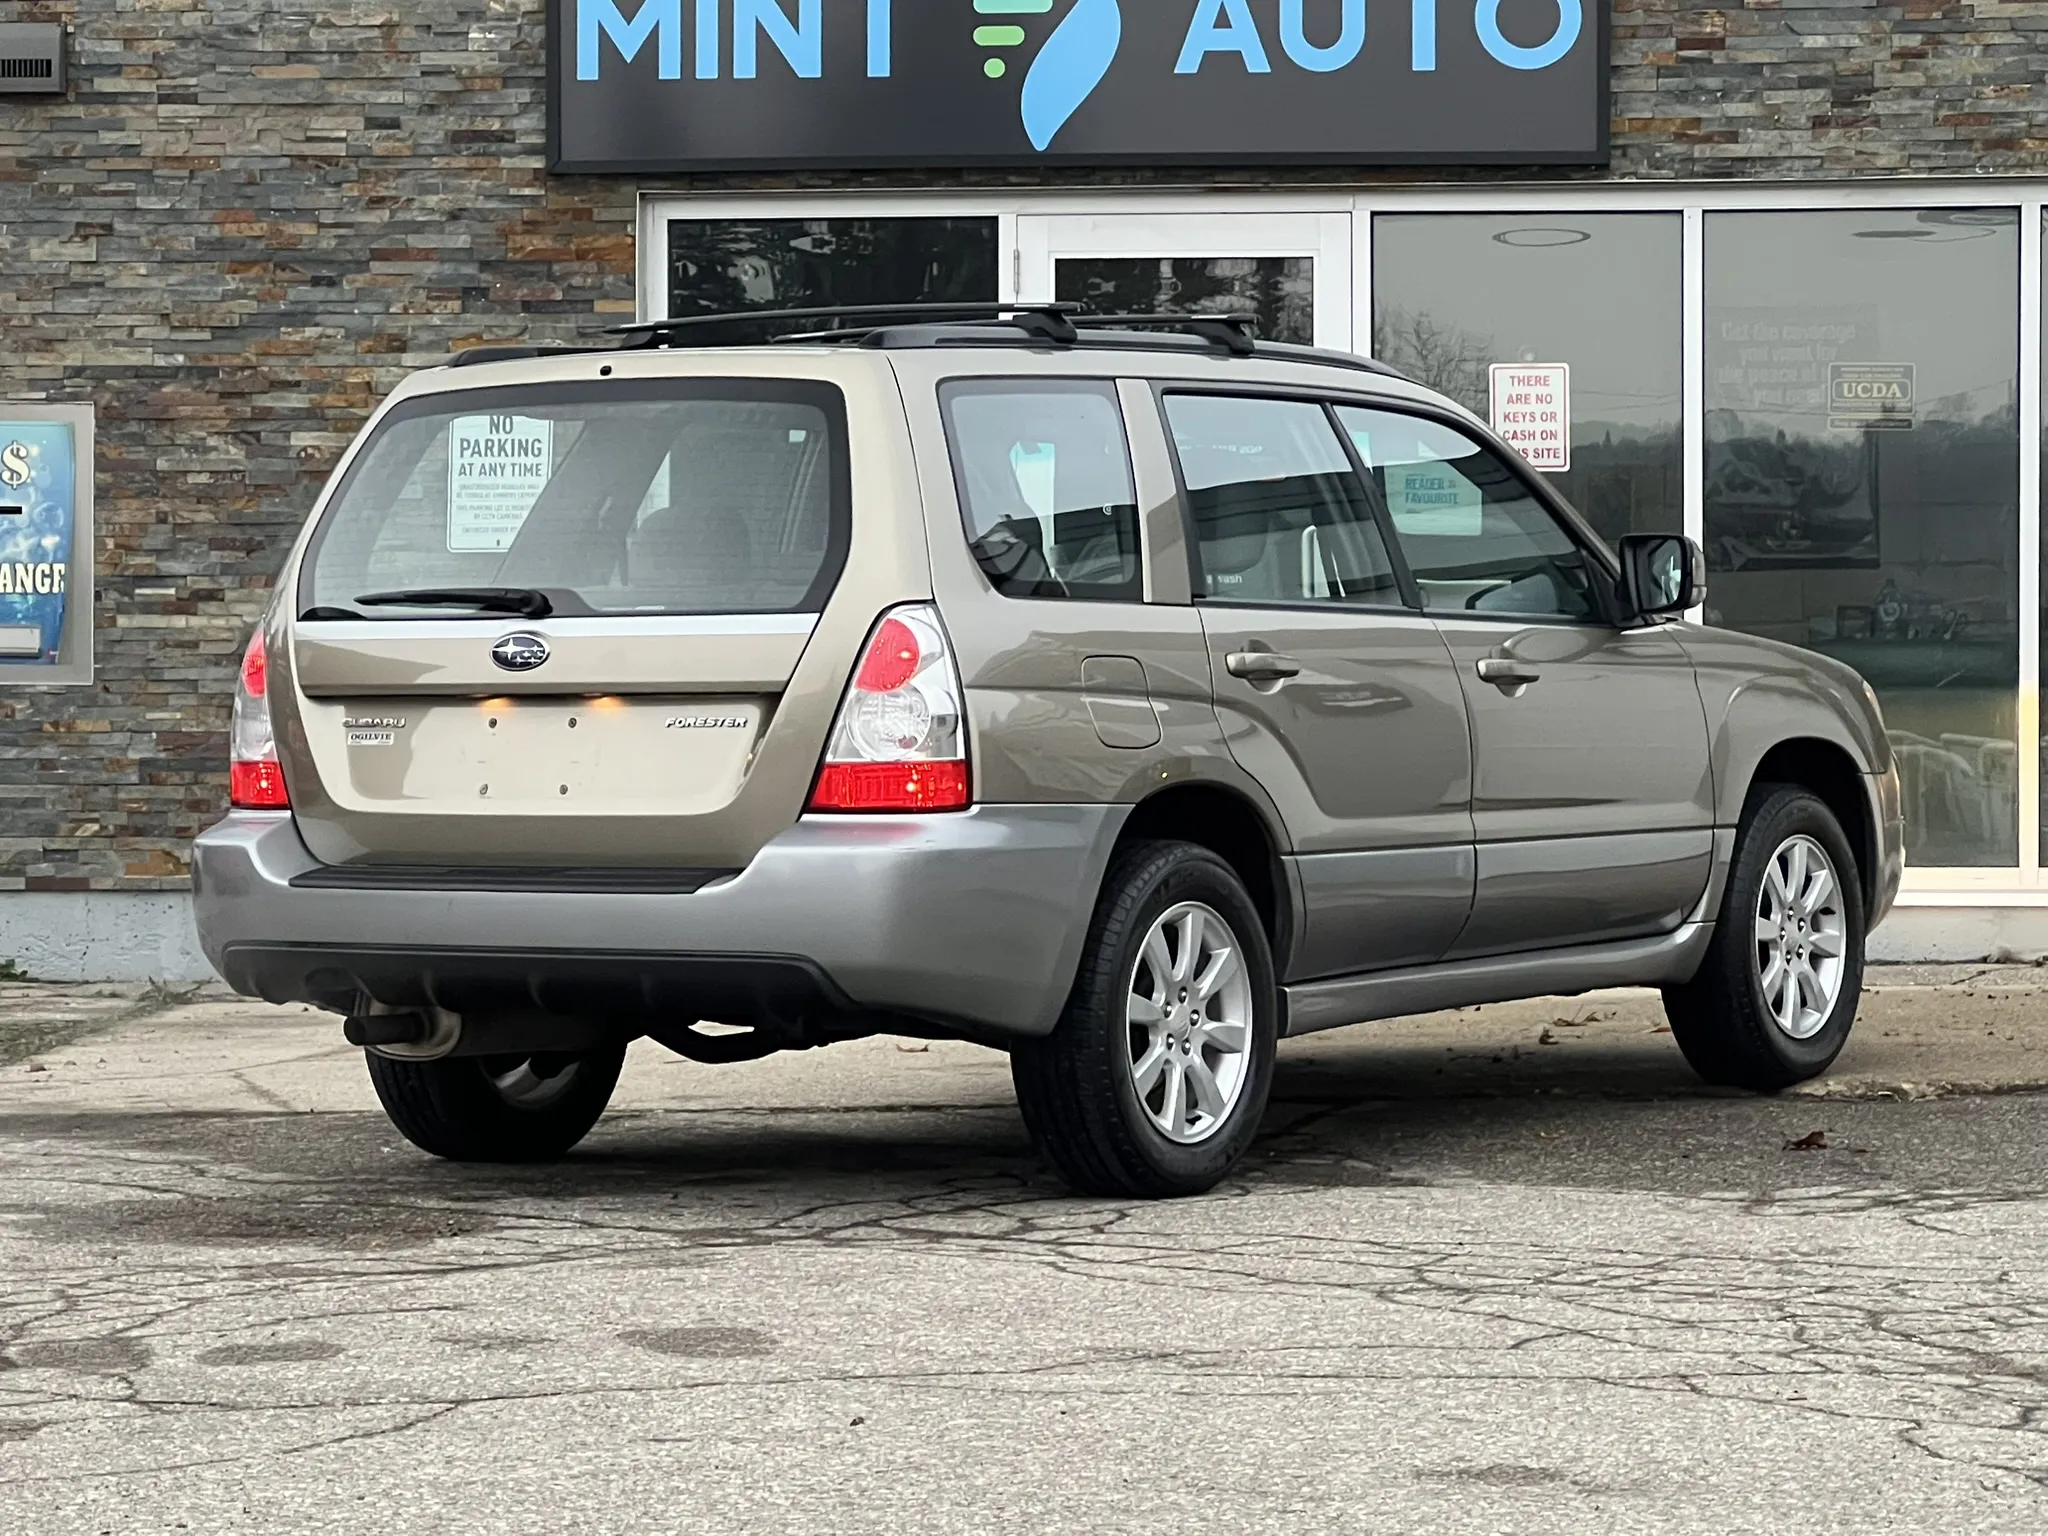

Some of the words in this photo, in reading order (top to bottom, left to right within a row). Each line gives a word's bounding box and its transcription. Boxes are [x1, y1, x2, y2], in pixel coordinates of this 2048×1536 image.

[1509, 375, 1551, 387] THERE
[1843, 382, 1903, 398] UCDA
[1506, 393, 1532, 405] ARE
[1535, 393, 1553, 405] NO
[1503, 411, 1536, 423] KEYS
[1540, 411, 1558, 423] OR
[489, 416, 514, 435] NO
[1502, 430, 1536, 441] CASH
[1540, 430, 1558, 441] ON
[460, 438, 542, 458] PARKING
[1533, 447, 1561, 459] SITE
[458, 463, 475, 477] AT
[478, 463, 507, 477] ANY
[510, 463, 542, 477] TIME
[341, 717, 407, 728] SUBARU
[665, 716, 748, 728] FORESTER
